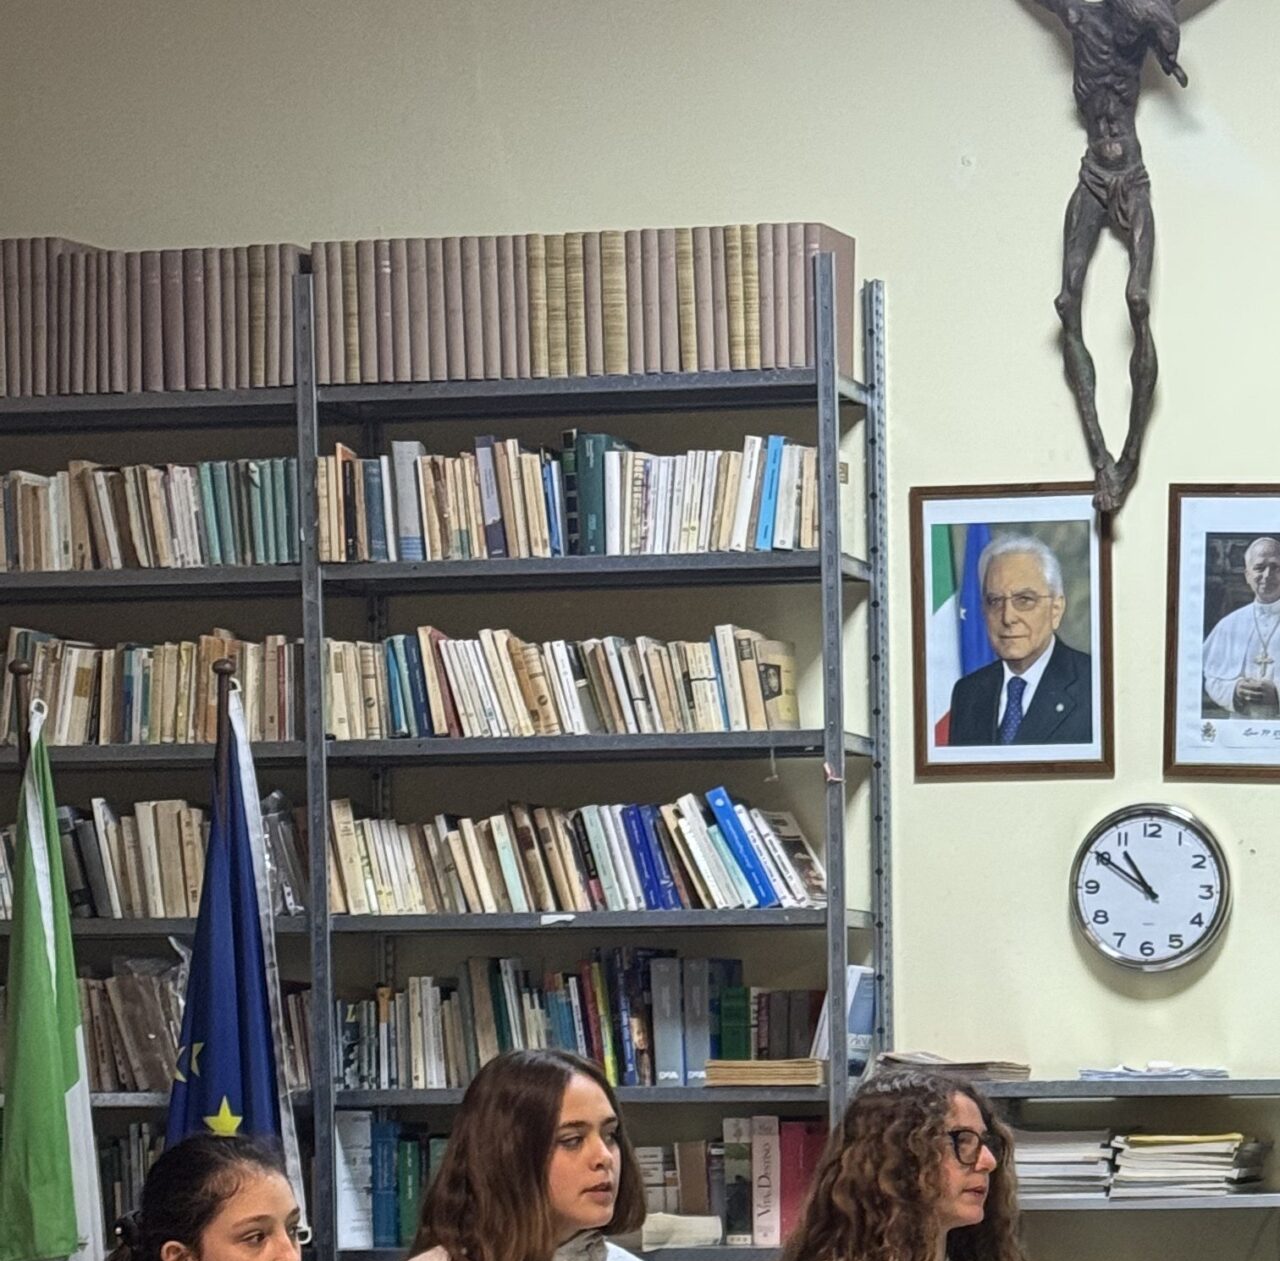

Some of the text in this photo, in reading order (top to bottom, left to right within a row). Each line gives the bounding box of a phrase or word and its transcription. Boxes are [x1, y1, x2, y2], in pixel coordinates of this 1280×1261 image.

[1143, 823, 1162, 838] 12
[1117, 832, 1129, 846] 11
[1177, 832, 1183, 846] 1
[1192, 855, 1207, 869] 2
[1085, 880, 1100, 894] 9
[1198, 885, 1214, 900] 3
[1093, 910, 1109, 924] 8
[1190, 913, 1204, 927] 4
[1113, 932, 1127, 948] 7
[1168, 934, 1184, 949] 5
[1139, 941, 1155, 956] 6
